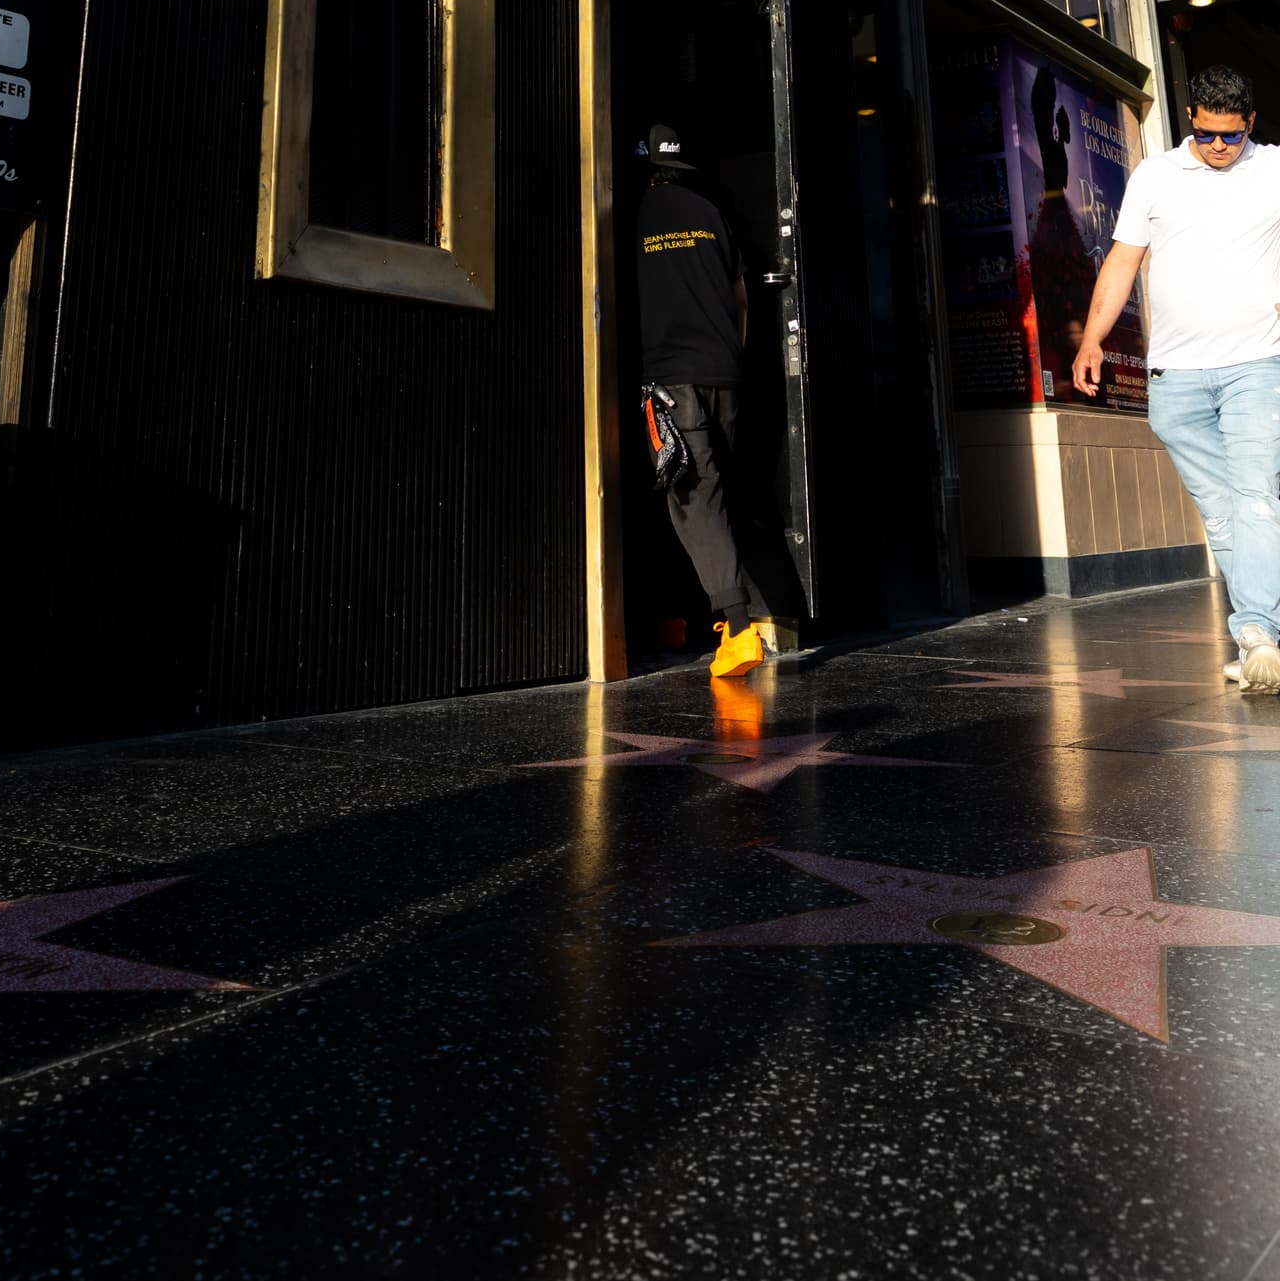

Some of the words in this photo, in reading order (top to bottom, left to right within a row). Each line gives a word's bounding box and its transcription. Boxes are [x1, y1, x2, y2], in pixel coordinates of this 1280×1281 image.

[1081, 111, 1091, 130] BE
[1092, 115, 1110, 140] OUR
[1084, 131, 1100, 155] LOS
[644, 243, 663, 254] KING
[664, 239, 696, 250] PLEASURE
[864, 874, 1021, 904] SYLVIA
[1053, 899, 1240, 932] SIDNE
